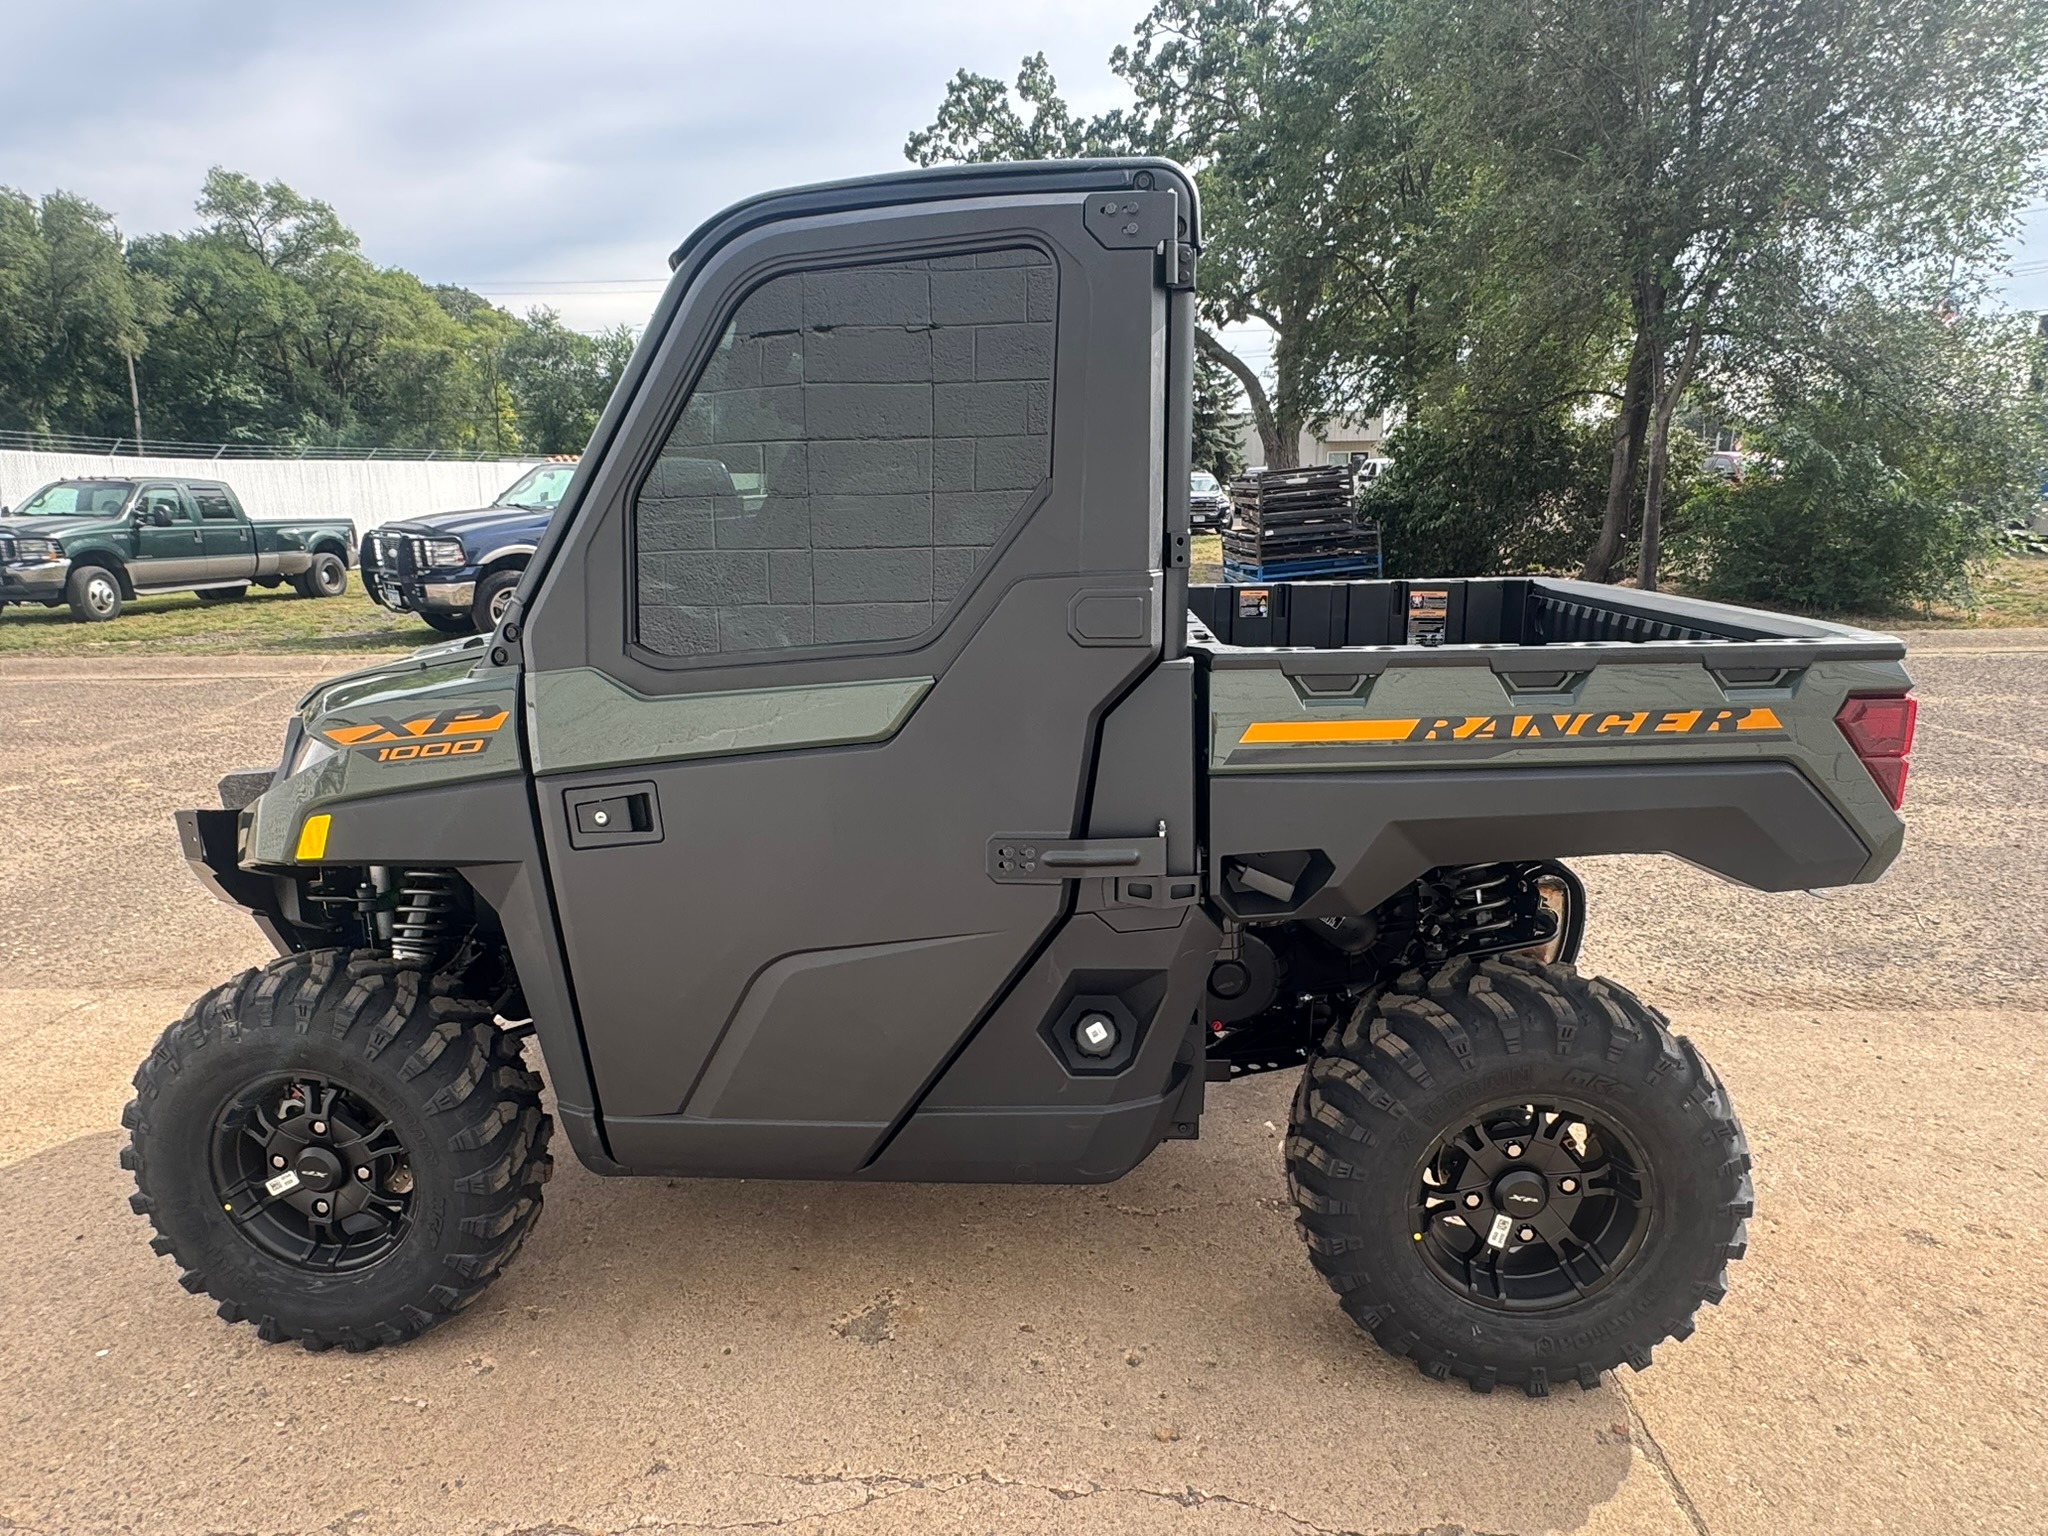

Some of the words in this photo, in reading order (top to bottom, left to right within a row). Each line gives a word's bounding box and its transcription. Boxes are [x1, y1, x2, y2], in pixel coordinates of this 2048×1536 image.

[350, 704, 503, 743] XP
[1405, 706, 1752, 742] RANGER
[377, 738, 485, 762] 1000
